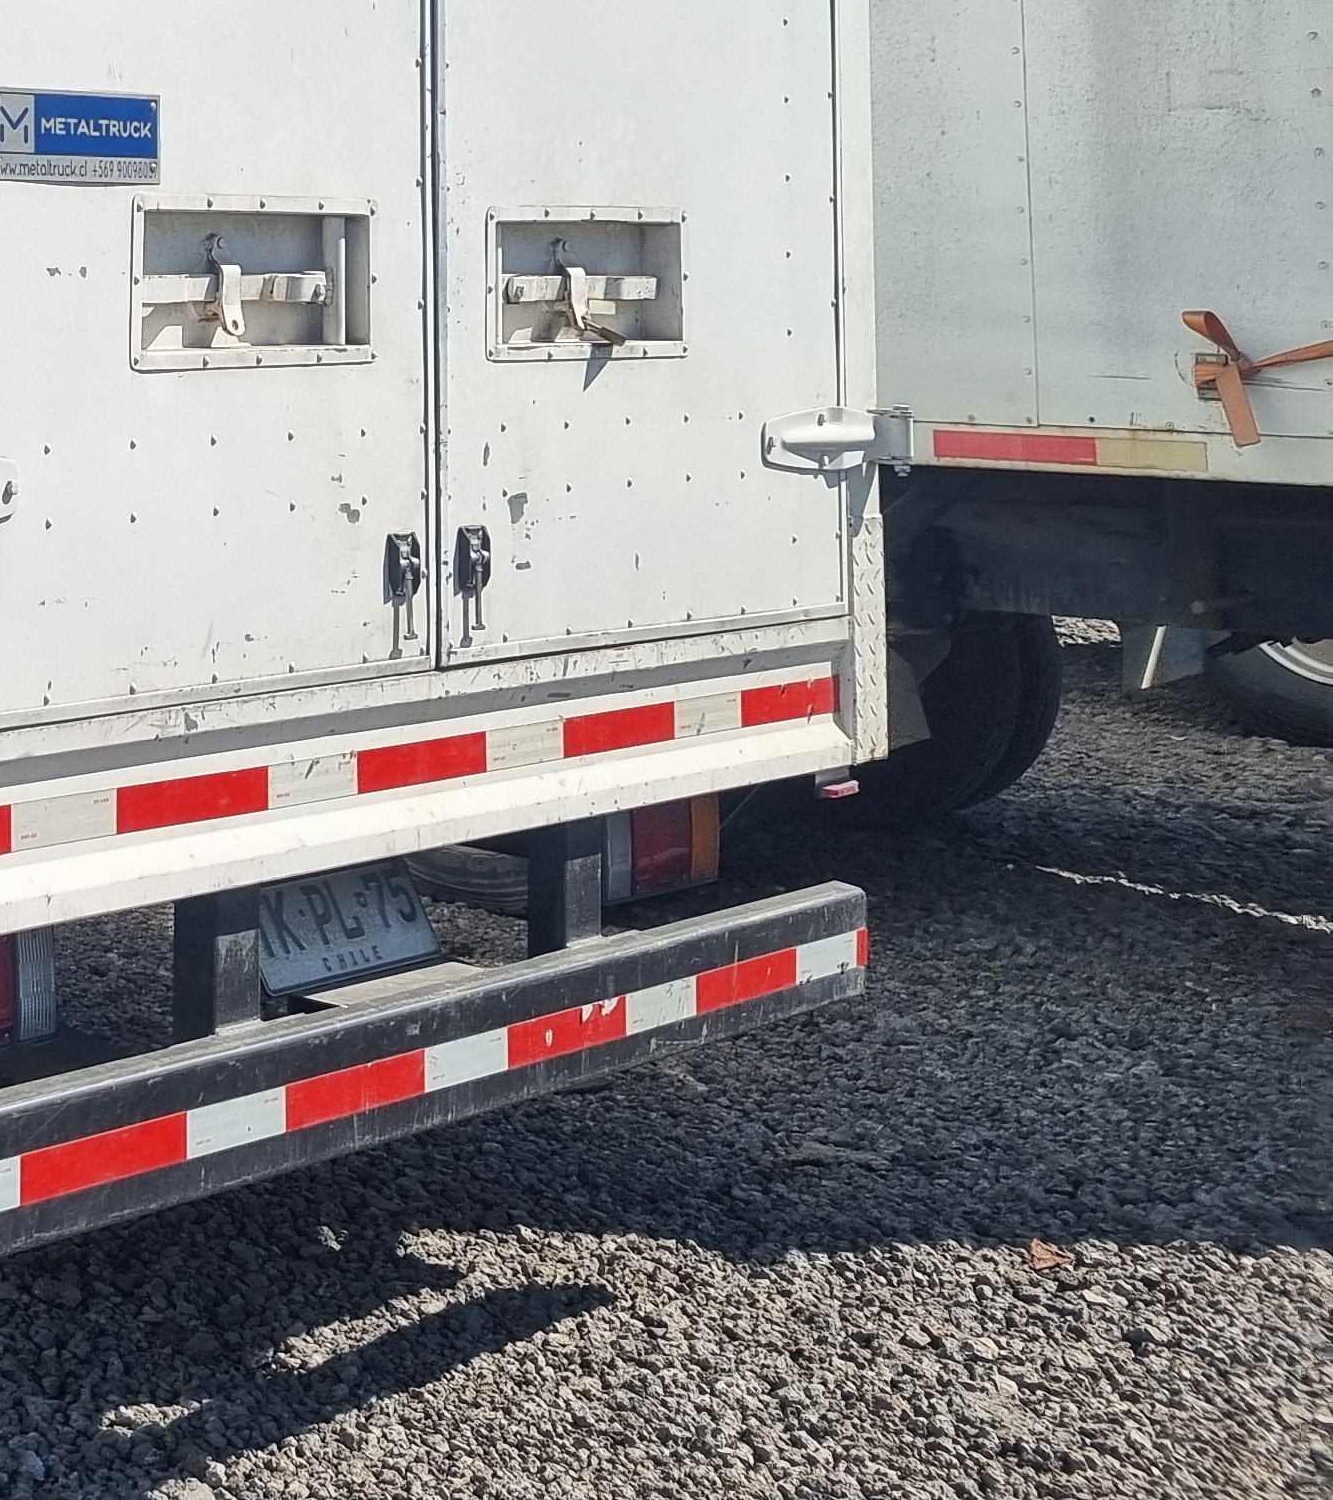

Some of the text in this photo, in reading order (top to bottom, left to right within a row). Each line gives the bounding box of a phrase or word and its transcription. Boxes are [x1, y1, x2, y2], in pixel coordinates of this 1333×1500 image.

[41, 117, 152, 138] METALTRUCK
[92, 160, 114, 178] +569
[322, 945, 383, 972] CHILE
